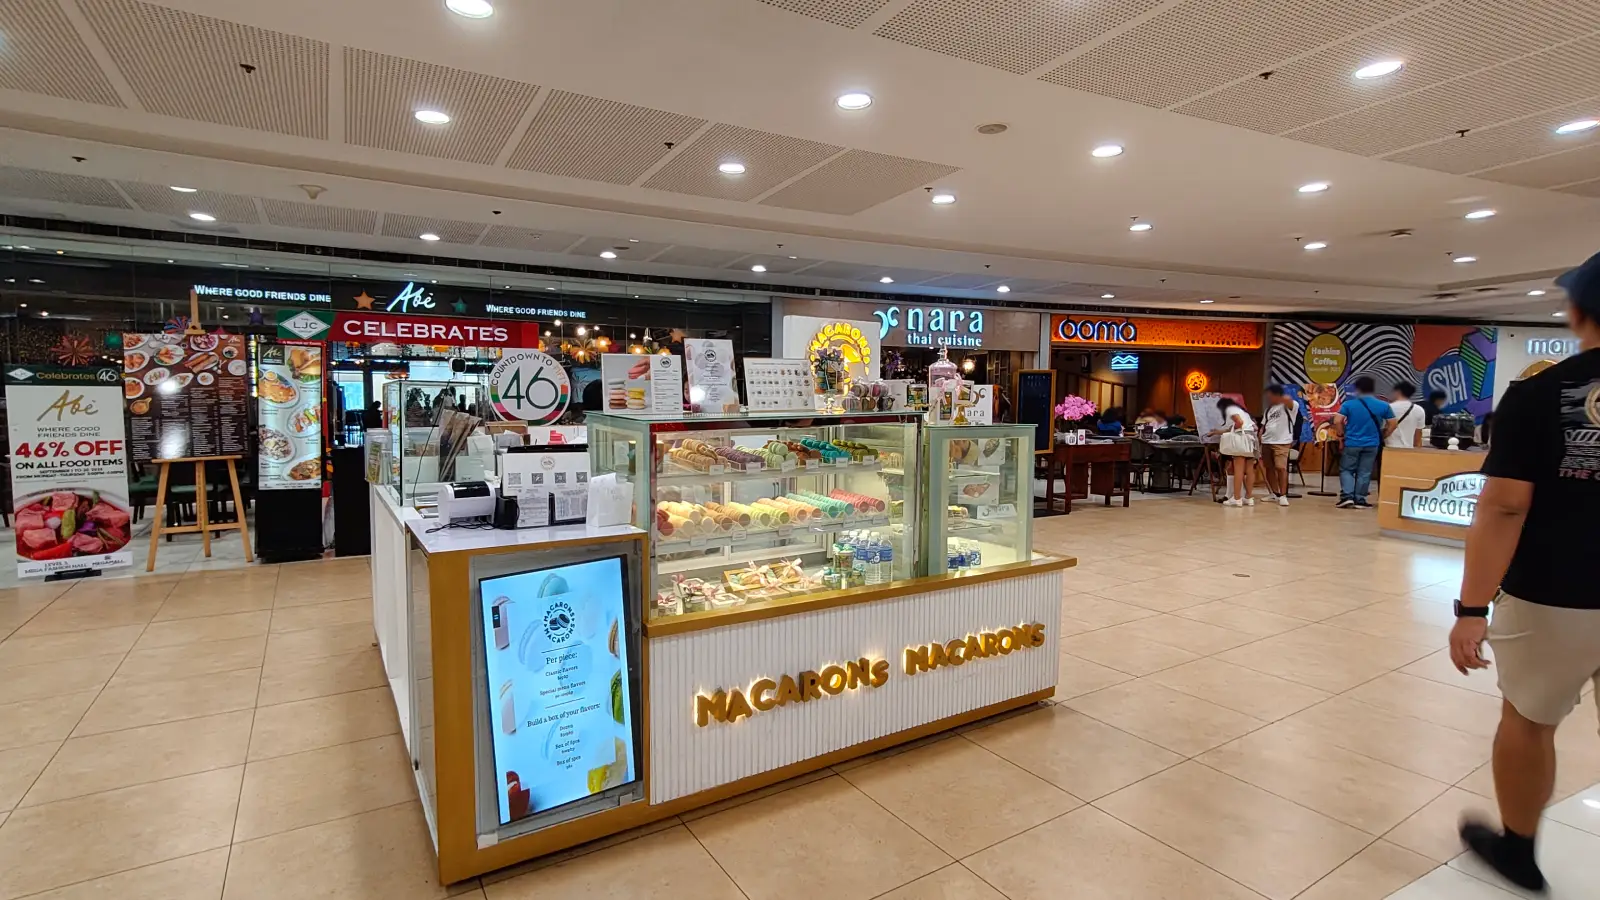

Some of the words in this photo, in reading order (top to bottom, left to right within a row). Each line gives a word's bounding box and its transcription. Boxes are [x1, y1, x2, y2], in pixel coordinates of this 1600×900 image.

[194, 284, 232, 296] WHERE
[235, 288, 263, 298] GOOD
[265, 288, 306, 301] FRIENDS
[309, 294, 332, 303] DINE
[386, 282, 436, 312] Abè
[486, 304, 514, 314] WHERE
[516, 306, 536, 316] GOOD
[538, 308, 568, 318] FRIENDS
[570, 310, 586, 318] DINE
[907, 307, 984, 333] nara
[294, 322, 318, 330] LJC
[343, 320, 508, 342] CELEBRATES
[809, 323, 870, 357] MACARONS
[908, 333, 932, 346] thai
[938, 334, 982, 347] cuisine
[1059, 320, 1137, 342] ooma
[100, 371, 117, 382] 46
[491, 352, 540, 386] COUNTDOWN
[541, 356, 552, 366] TO
[502, 366, 558, 410] 46
[37, 390, 98, 422] Abè
[15, 442, 70, 458] 46%
[74, 440, 122, 456] OFF
[60, 460, 91, 468] FOOD
[1441, 478, 1476, 495] ROCKY
[544, 601, 576, 622] MACARONS
[544, 624, 576, 644] MACARONS
[546, 656, 558, 664] Per
[558, 652, 578, 664] piece:
[694, 657, 890, 728] MACARONS
[904, 622, 1046, 676] MACARONS
[540, 686, 556, 696] Special
[527, 718, 543, 727] Build
[560, 711, 565, 719] of
[565, 709, 579, 718] your
[580, 703, 601, 713] flavors:
